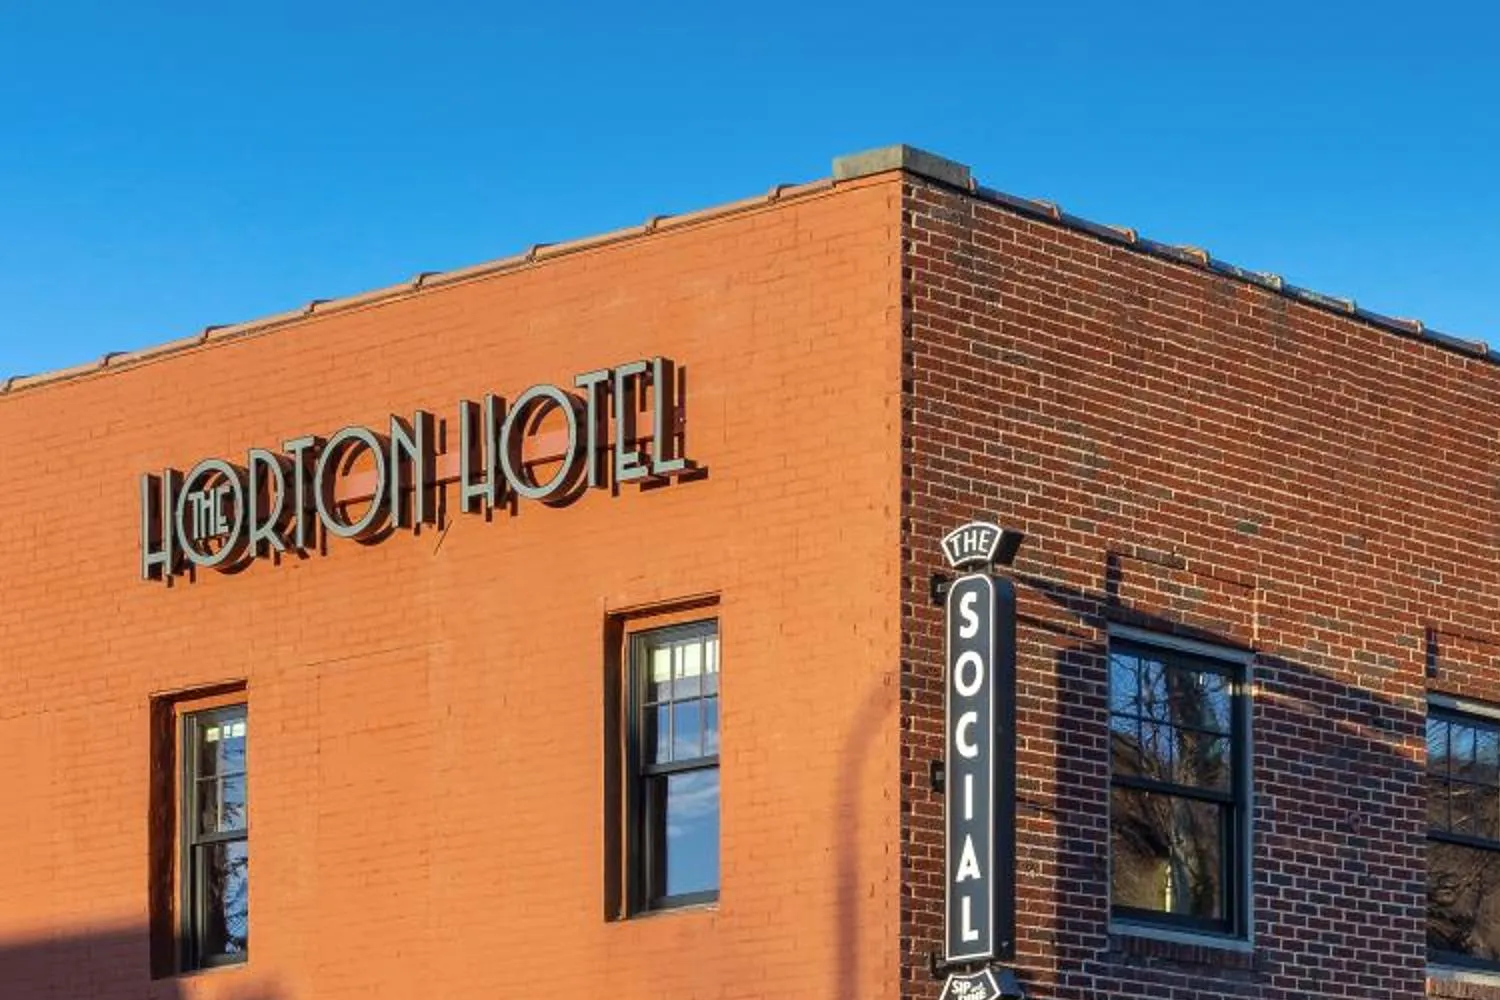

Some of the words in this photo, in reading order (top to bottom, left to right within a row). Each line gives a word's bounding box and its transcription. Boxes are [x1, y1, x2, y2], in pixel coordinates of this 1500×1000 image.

[140, 409, 431, 580] HORTON
[460, 356, 687, 514] HOTEL
[187, 484, 231, 540] THE
[949, 529, 991, 557] THE
[954, 591, 985, 943] SOCIAL
[951, 980, 971, 994] SIP
